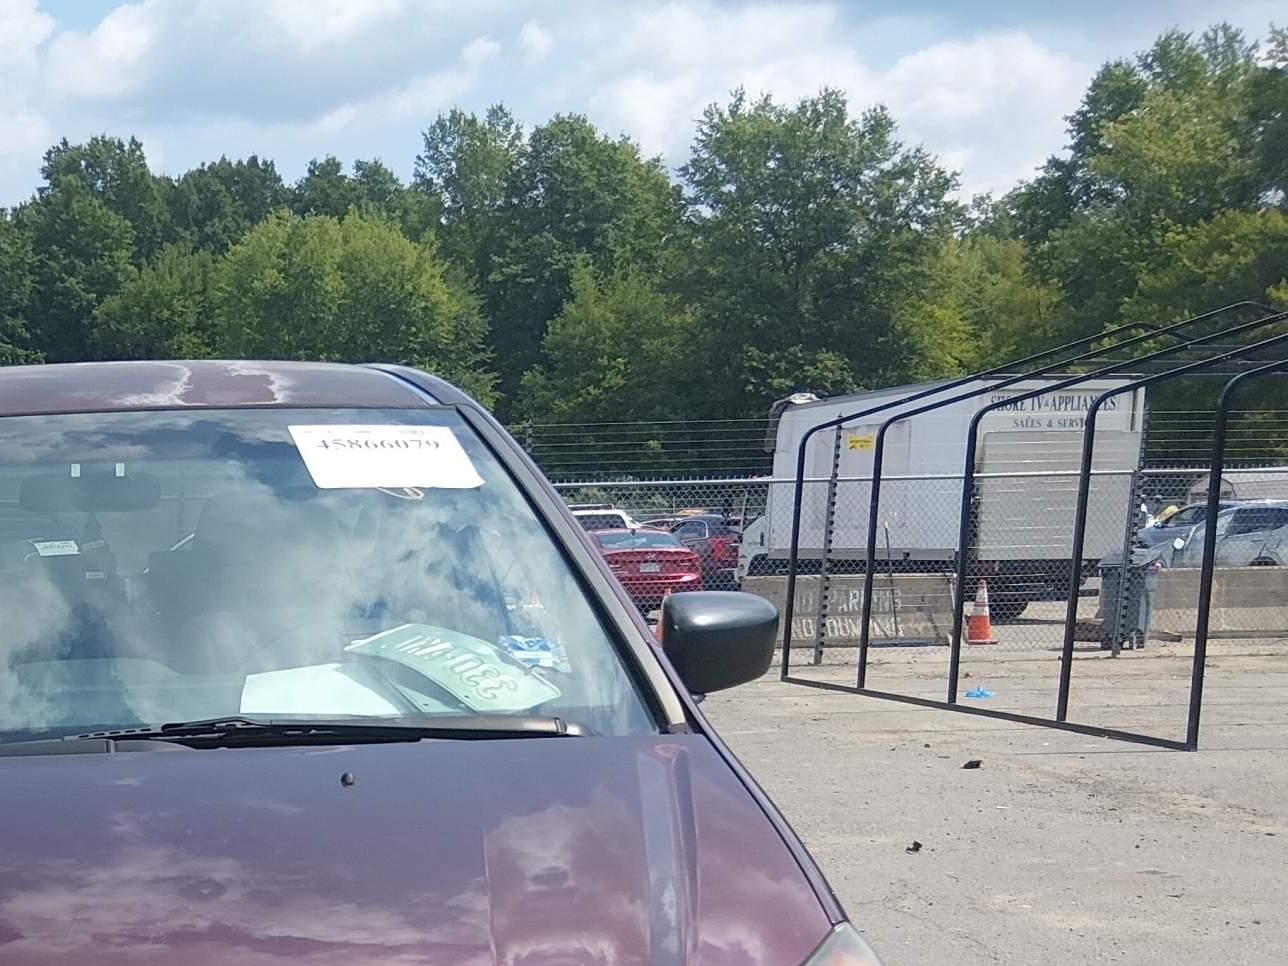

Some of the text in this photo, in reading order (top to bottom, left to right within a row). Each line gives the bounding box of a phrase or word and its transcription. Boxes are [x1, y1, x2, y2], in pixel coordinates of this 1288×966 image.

[1050, 395, 1116, 411] APPLIANES
[1057, 418, 1087, 428] SERVI
[316, 439, 440, 450] 45866079
